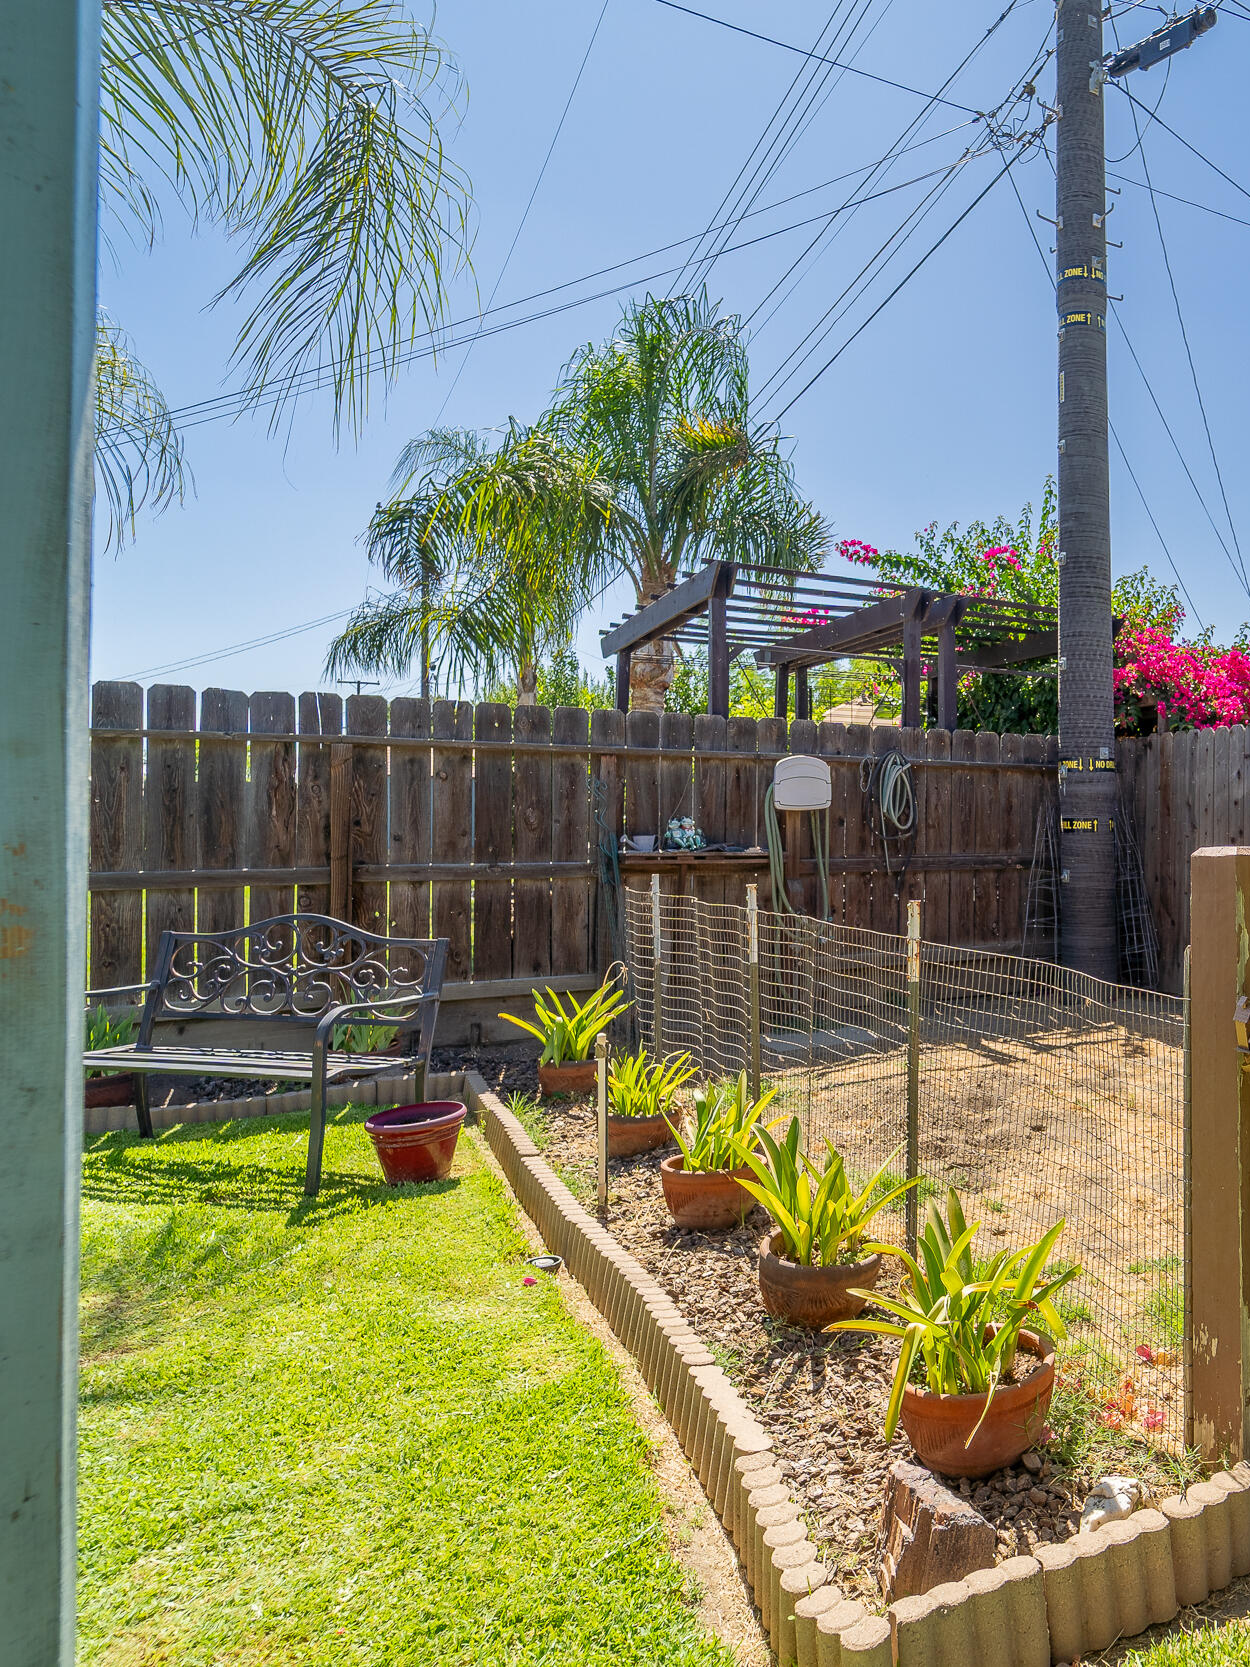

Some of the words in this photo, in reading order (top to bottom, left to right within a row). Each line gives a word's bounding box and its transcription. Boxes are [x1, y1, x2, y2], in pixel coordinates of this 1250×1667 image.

[1064, 268, 1083, 277] ZONE
[1066, 314, 1086, 323] ZONE
[1095, 760, 1105, 769] NO
[1072, 821, 1092, 829] ZONE
